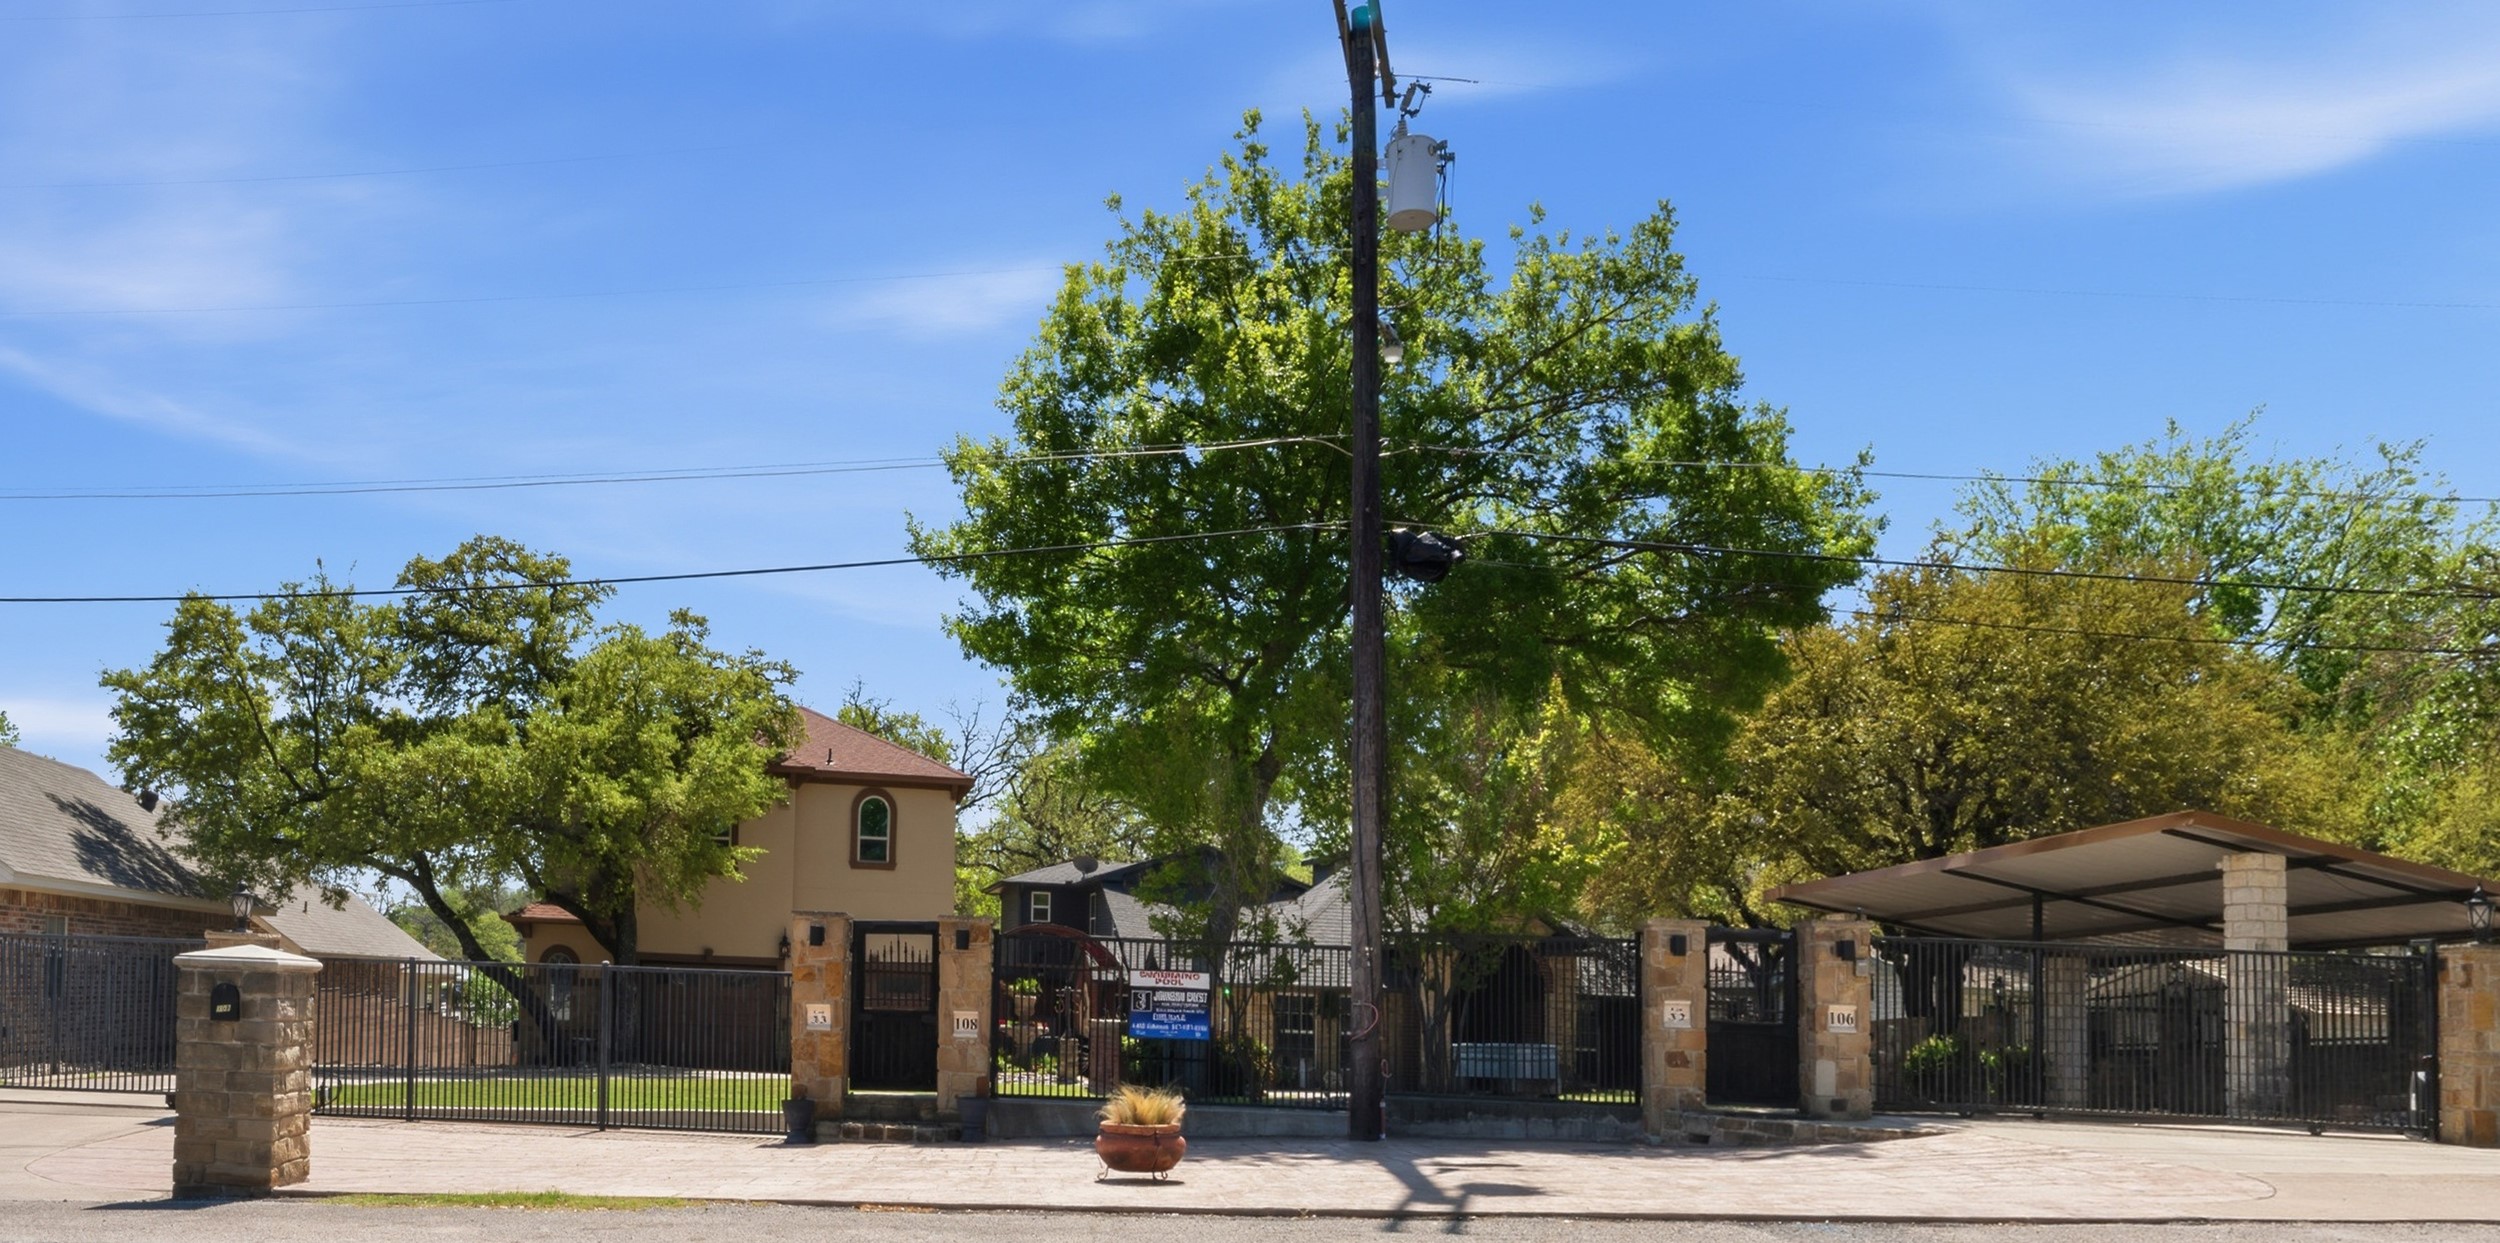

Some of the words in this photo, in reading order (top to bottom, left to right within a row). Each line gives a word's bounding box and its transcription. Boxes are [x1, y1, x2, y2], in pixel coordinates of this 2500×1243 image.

[1155, 978, 1184, 986] POOL
[956, 1018, 978, 1030] 108
[1830, 1012, 1854, 1025] 106
